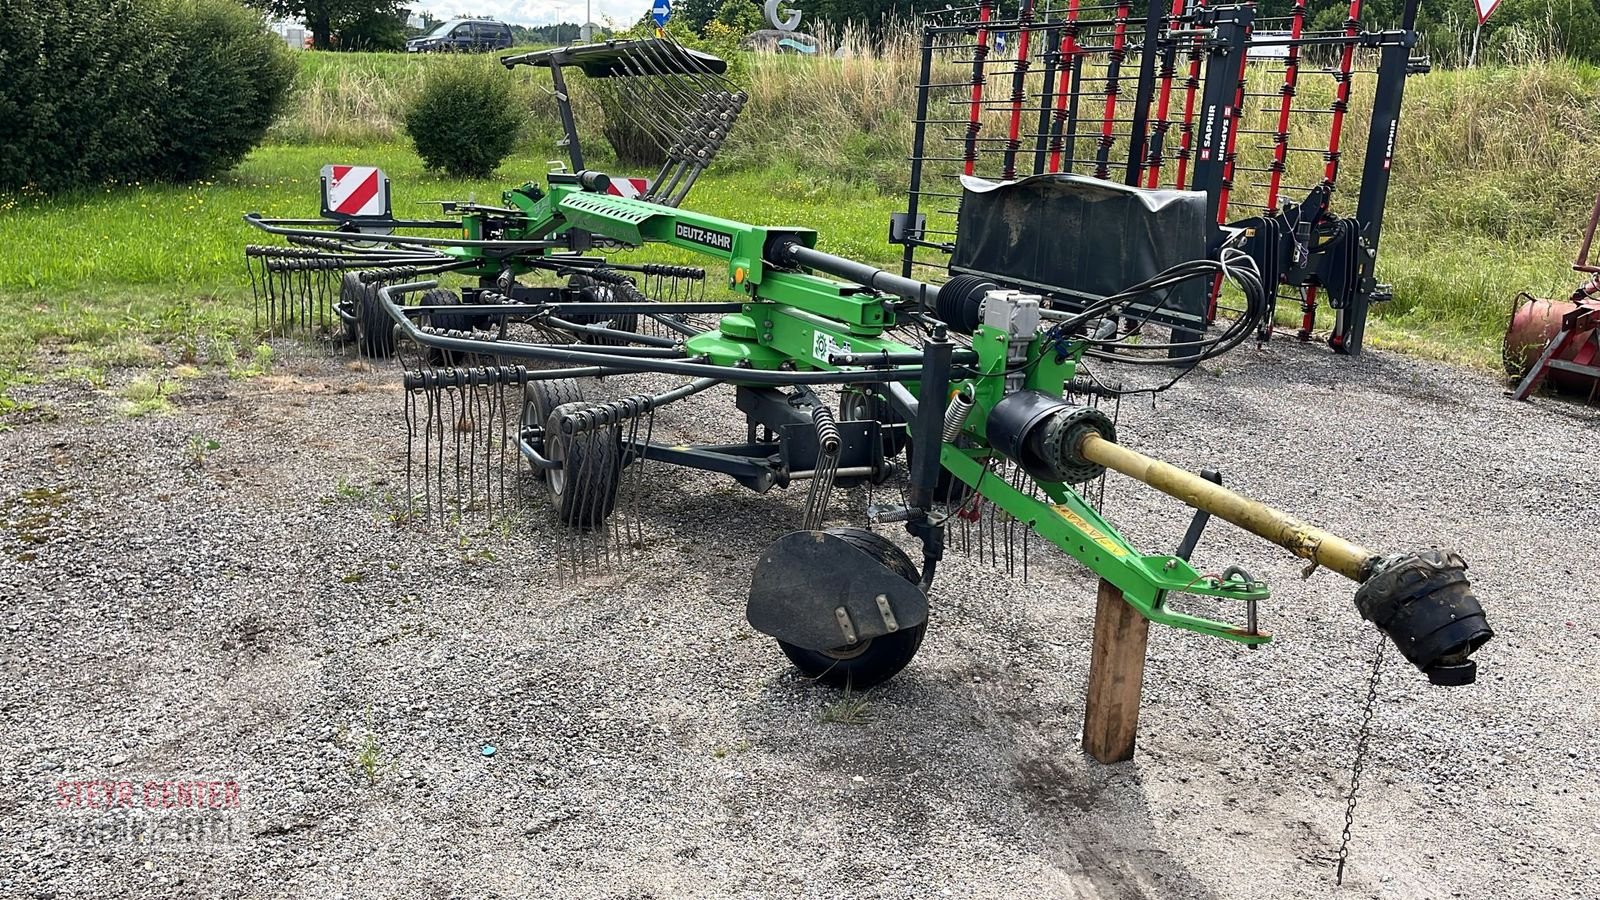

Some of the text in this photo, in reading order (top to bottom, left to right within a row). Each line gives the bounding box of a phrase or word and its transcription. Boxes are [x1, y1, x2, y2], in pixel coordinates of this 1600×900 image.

[1204, 105, 1216, 148] SAPHIR
[1218, 119, 1229, 161] SAPHIR
[1386, 119, 1397, 157] SAPHIR
